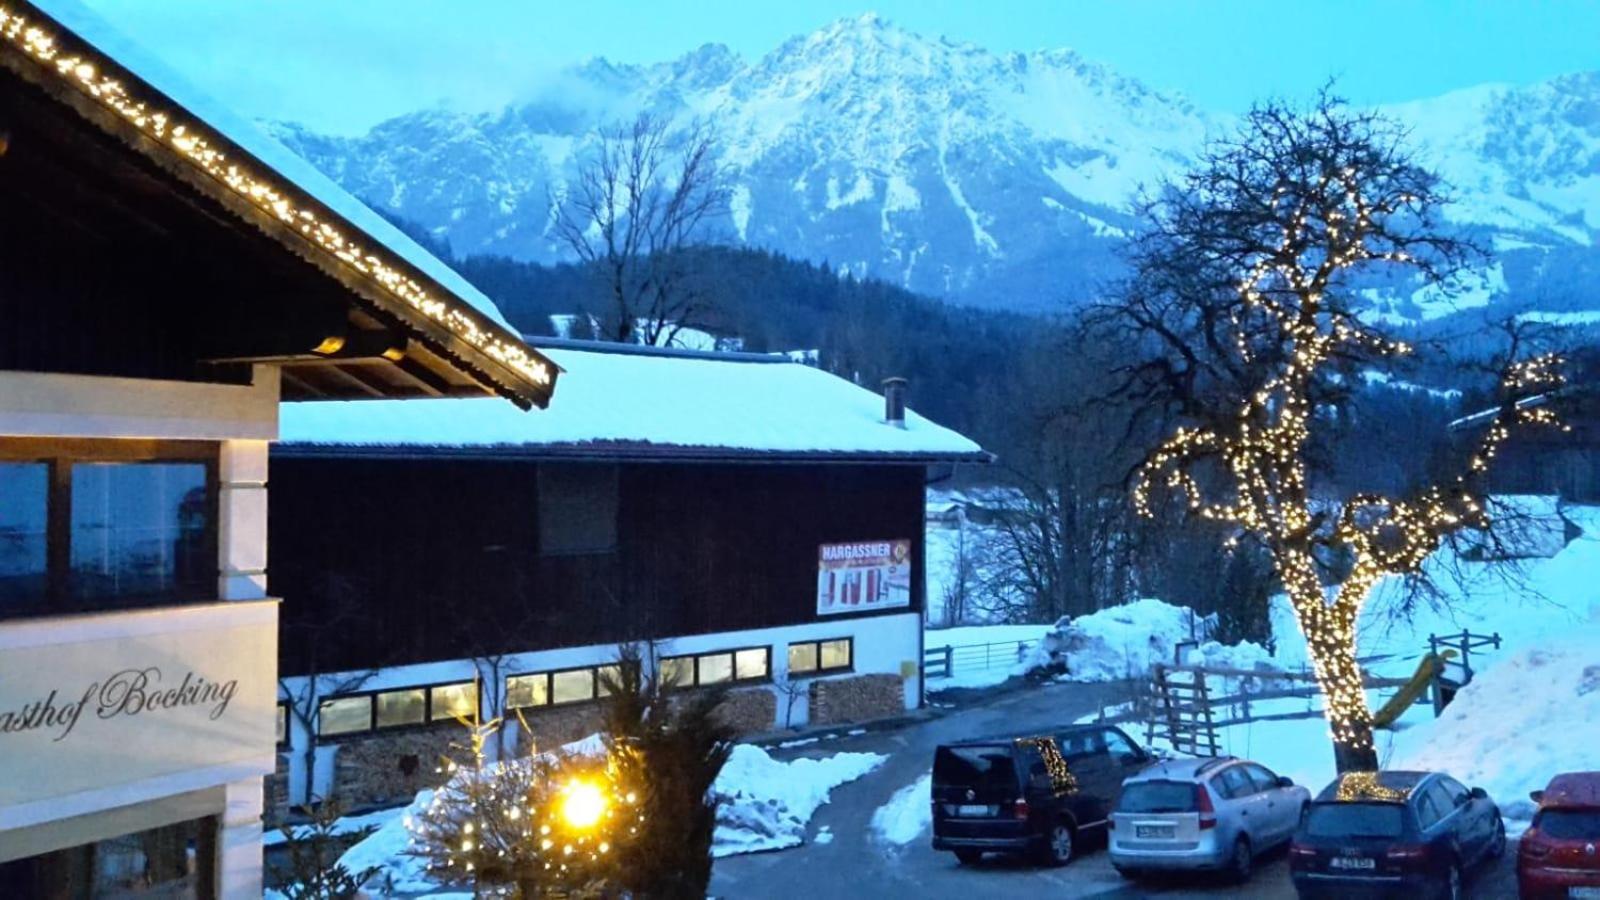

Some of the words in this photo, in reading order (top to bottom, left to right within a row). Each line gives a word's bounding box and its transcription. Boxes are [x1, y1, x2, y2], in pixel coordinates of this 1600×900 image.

[822, 543, 890, 560] HARGASSNER
[0, 682, 98, 742] asthof
[97, 667, 238, 720] Bocking
